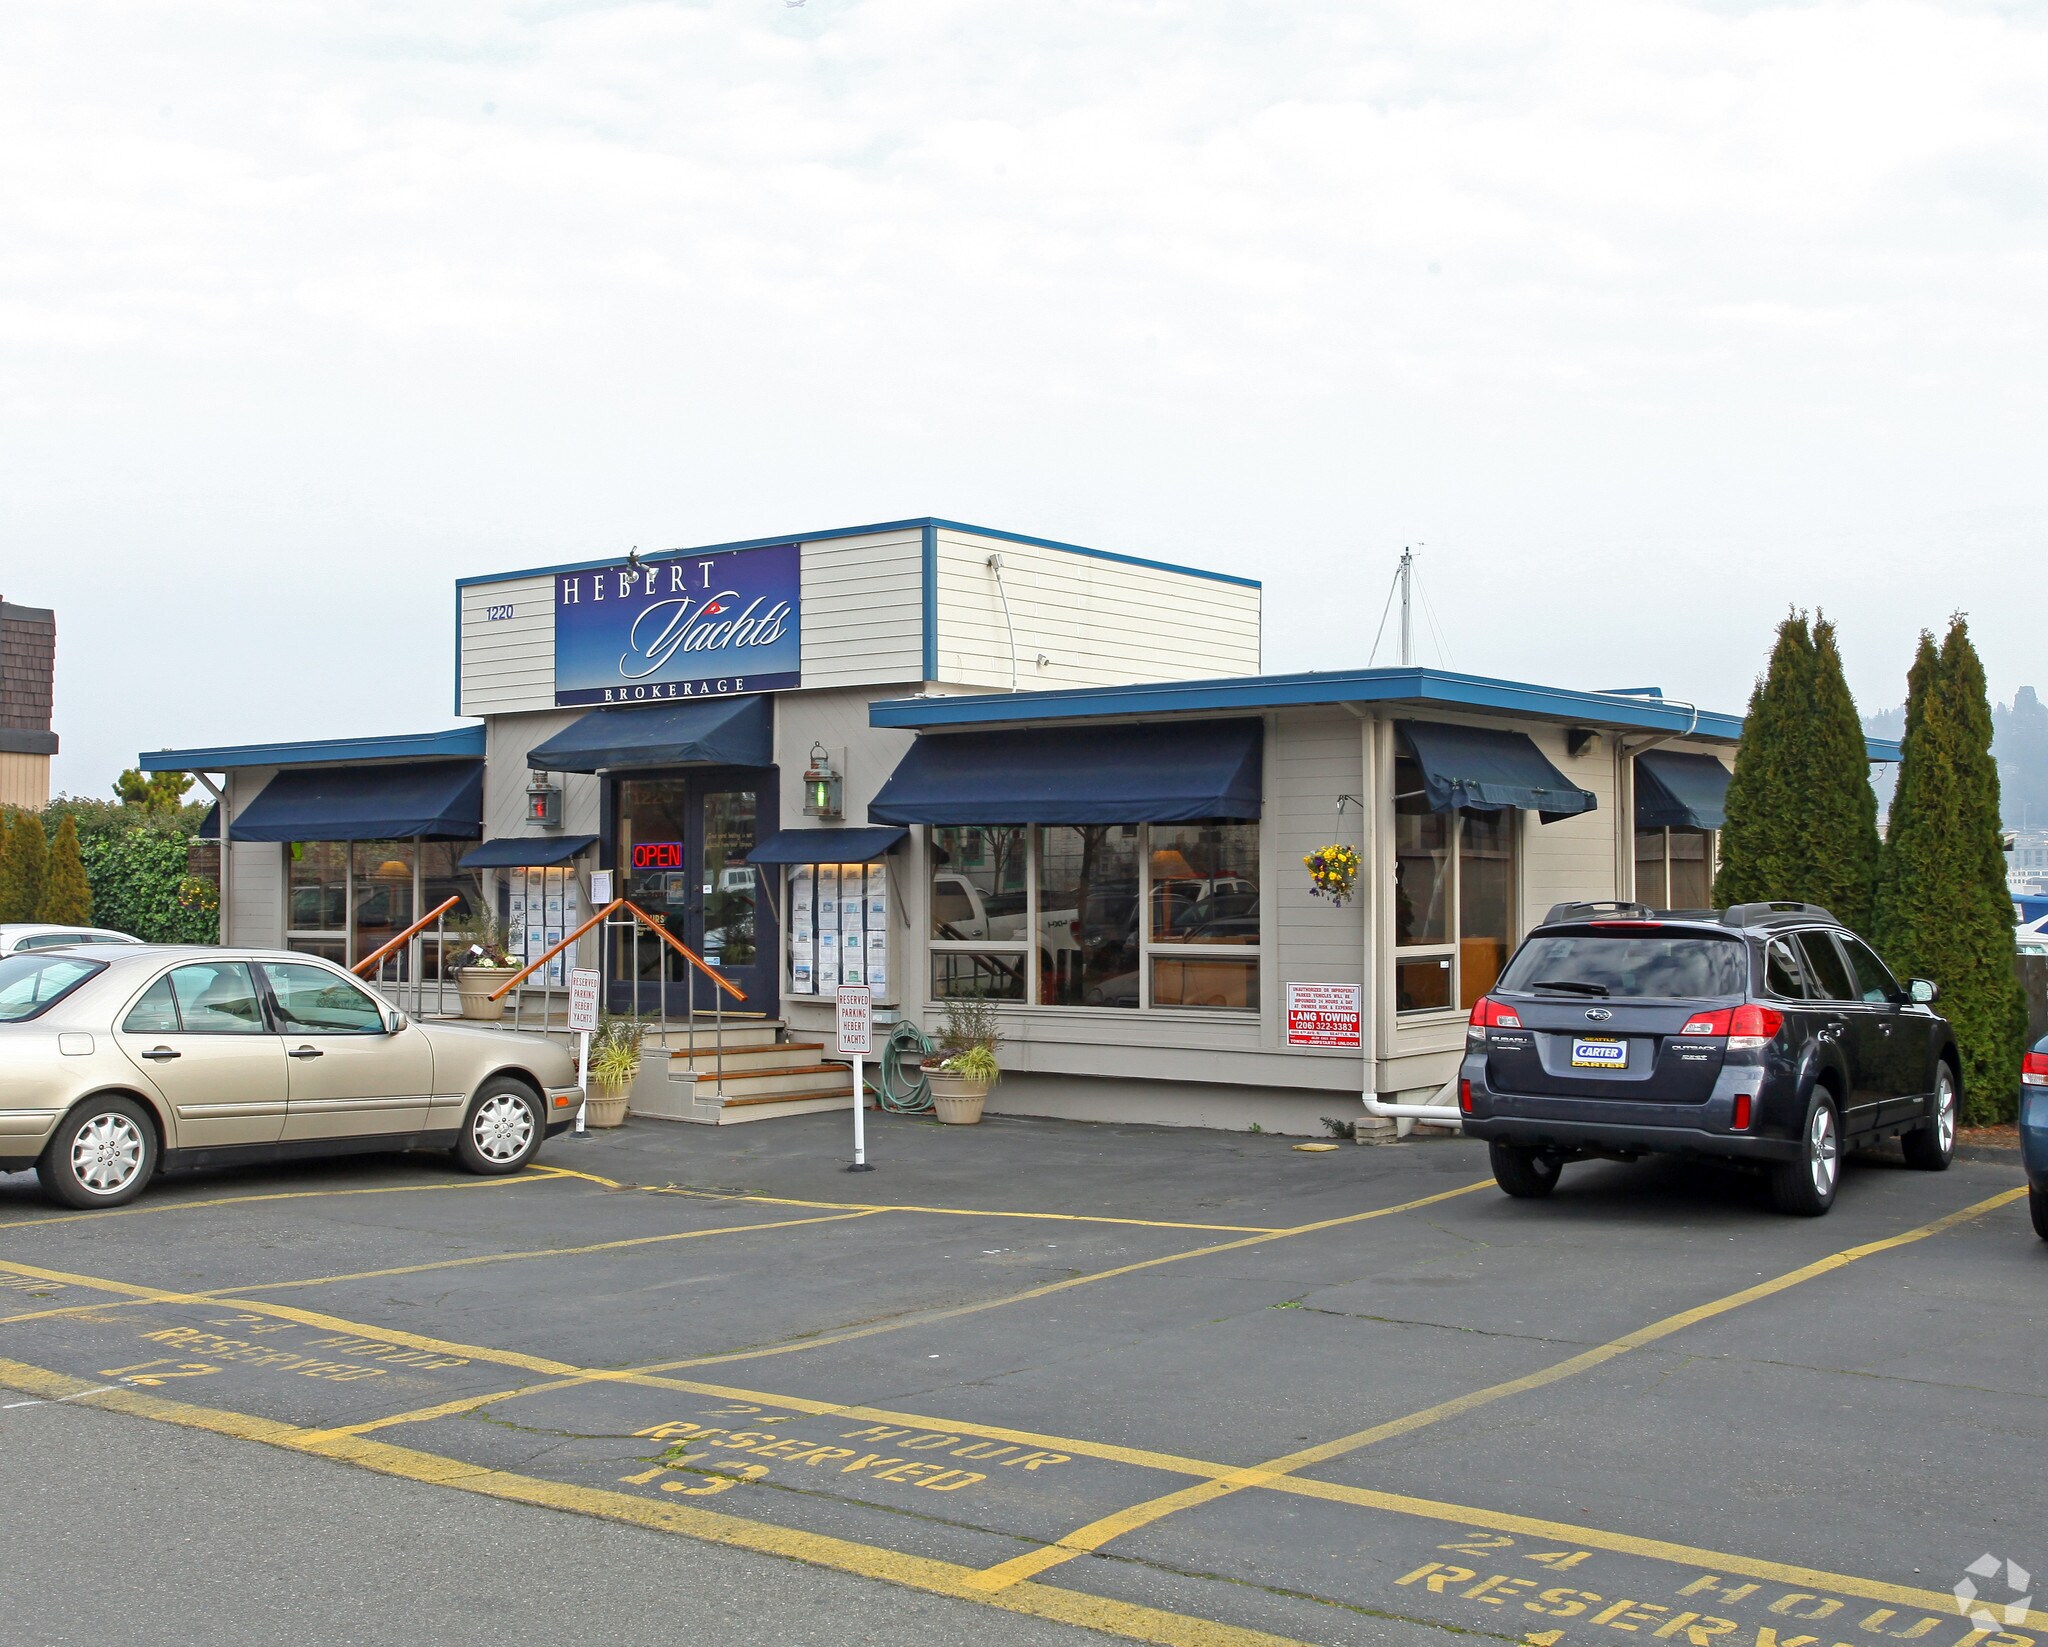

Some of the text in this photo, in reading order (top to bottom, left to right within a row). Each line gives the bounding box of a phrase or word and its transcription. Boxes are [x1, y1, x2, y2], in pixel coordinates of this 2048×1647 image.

[563, 561, 714, 605] HEBERT
[486, 604, 514, 621] 1220
[619, 590, 791, 679] Yachts
[604, 678, 744, 701] BROKERAGE
[634, 844, 681, 867] OPEN
[573, 977, 597, 988] RESERVED
[574, 989, 595, 1000] PARKING
[839, 995, 869, 1005] RESERVED
[575, 1002, 593, 1011] HEBERT
[573, 1013, 593, 1023] YACHTS
[842, 1008, 866, 1018] PARKING
[1290, 1012, 1357, 1023] LANG TOWING
[843, 1022, 865, 1031] HEBERT
[1295, 1021, 1353, 1031] (206) 322-3383
[843, 1035, 866, 1045] YACHTS
[1578, 1046, 1618, 1058] CARTER
[138, 1326, 388, 1382] RESERVED
[304, 1336, 471, 1370] HOUR
[839, 1426, 1072, 1470] HOUR
[633, 1420, 988, 1492] RESERVED
[1436, 1533, 1593, 1572] 24
